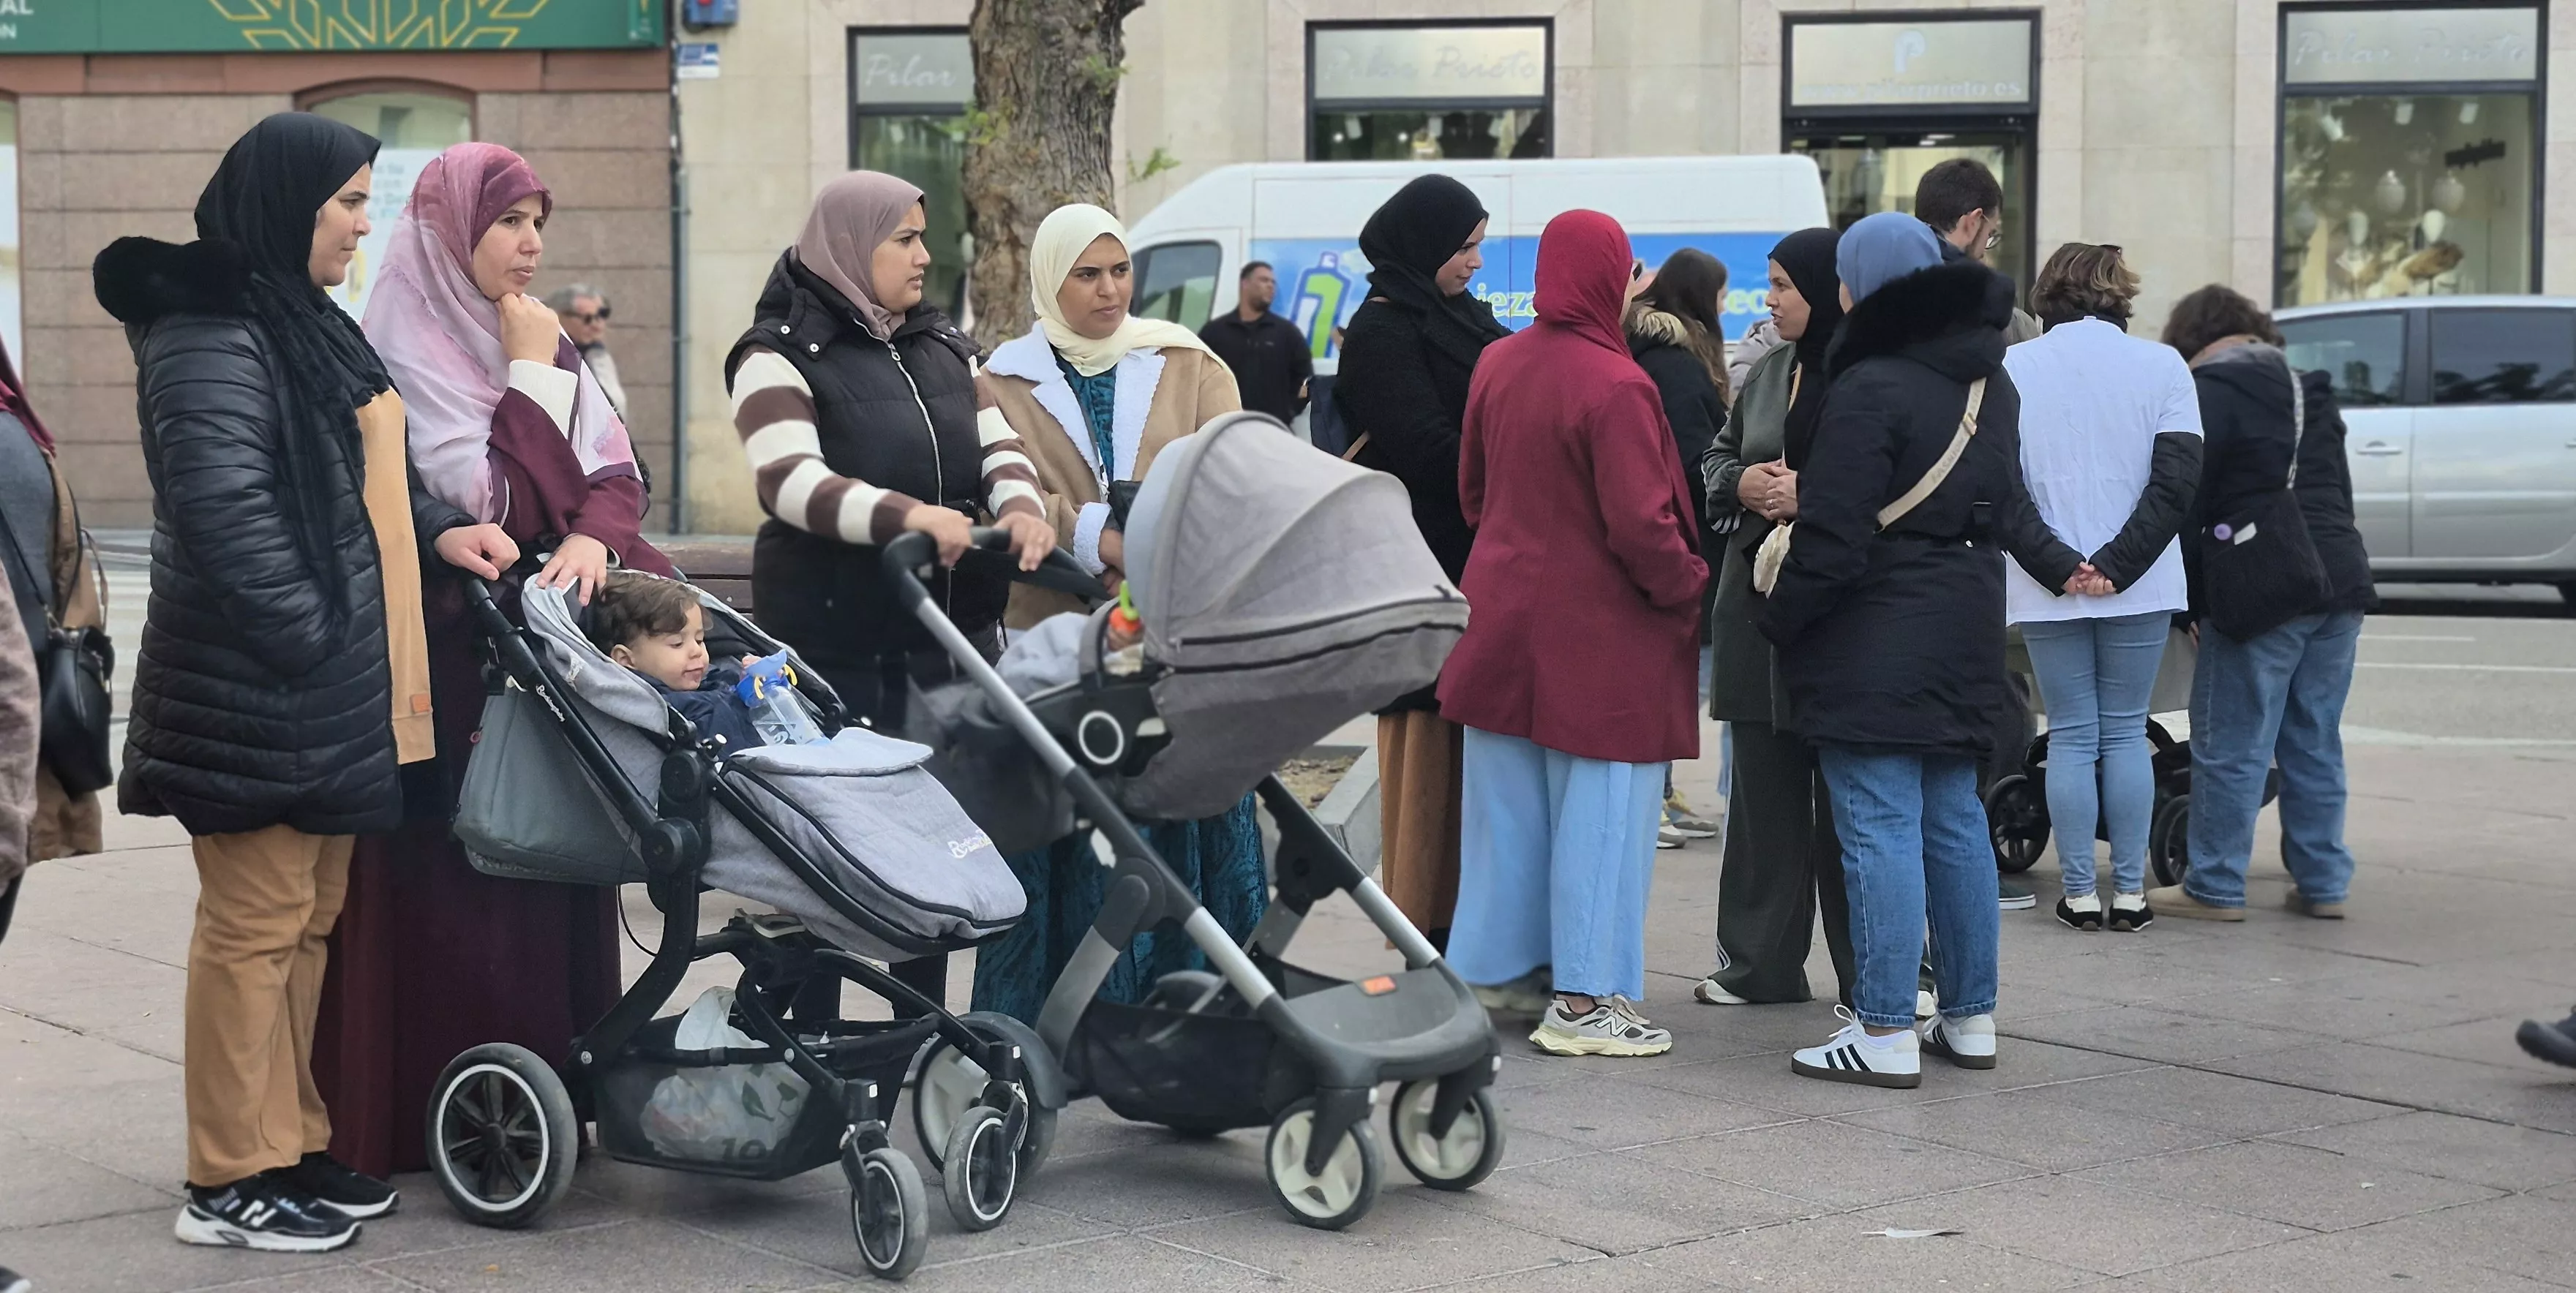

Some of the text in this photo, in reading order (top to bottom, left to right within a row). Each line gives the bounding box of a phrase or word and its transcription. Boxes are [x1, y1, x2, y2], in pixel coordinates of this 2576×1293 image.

[1432, 45, 1537, 79] Prieto
[2295, 29, 2392, 65] Pilar
[865, 53, 956, 87] Pilar
